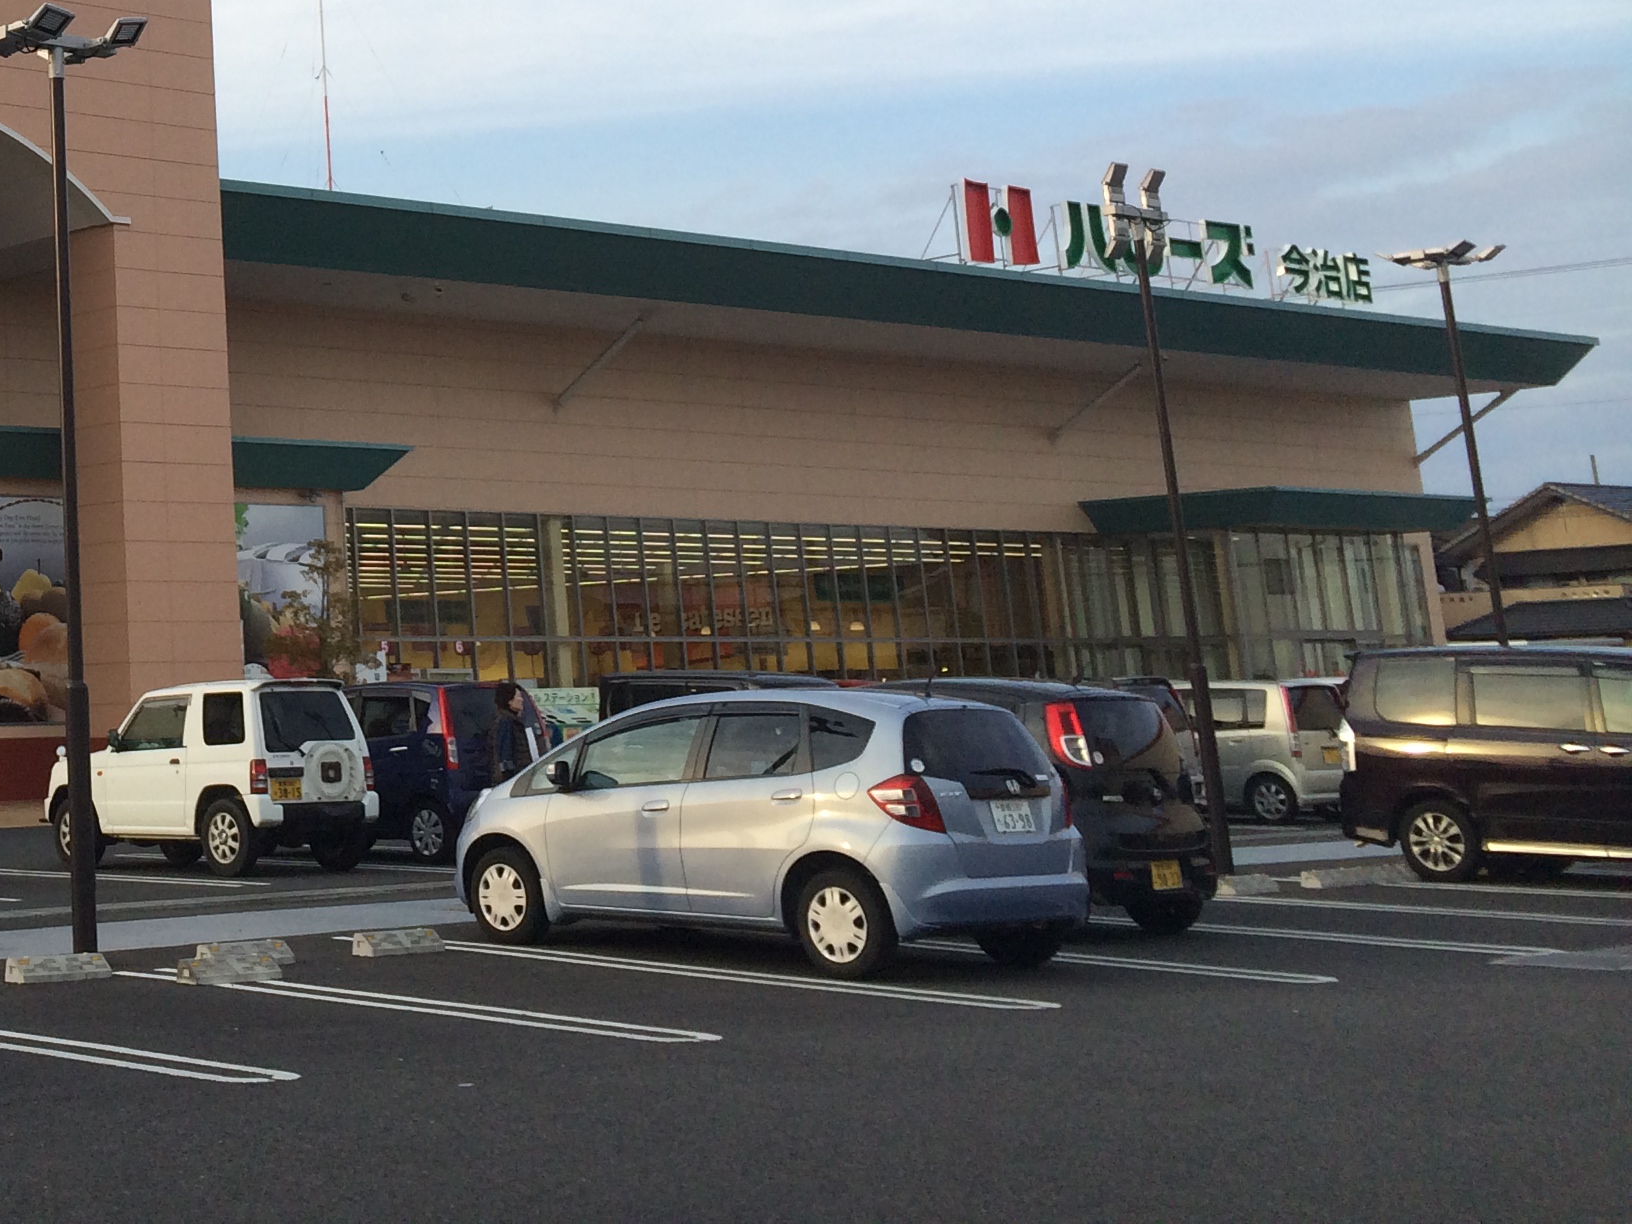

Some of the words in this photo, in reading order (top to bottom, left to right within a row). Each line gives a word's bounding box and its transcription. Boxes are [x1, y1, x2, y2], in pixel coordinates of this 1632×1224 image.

[1275, 243, 1374, 304] 今治店
[455, 641, 464, 653] 6
